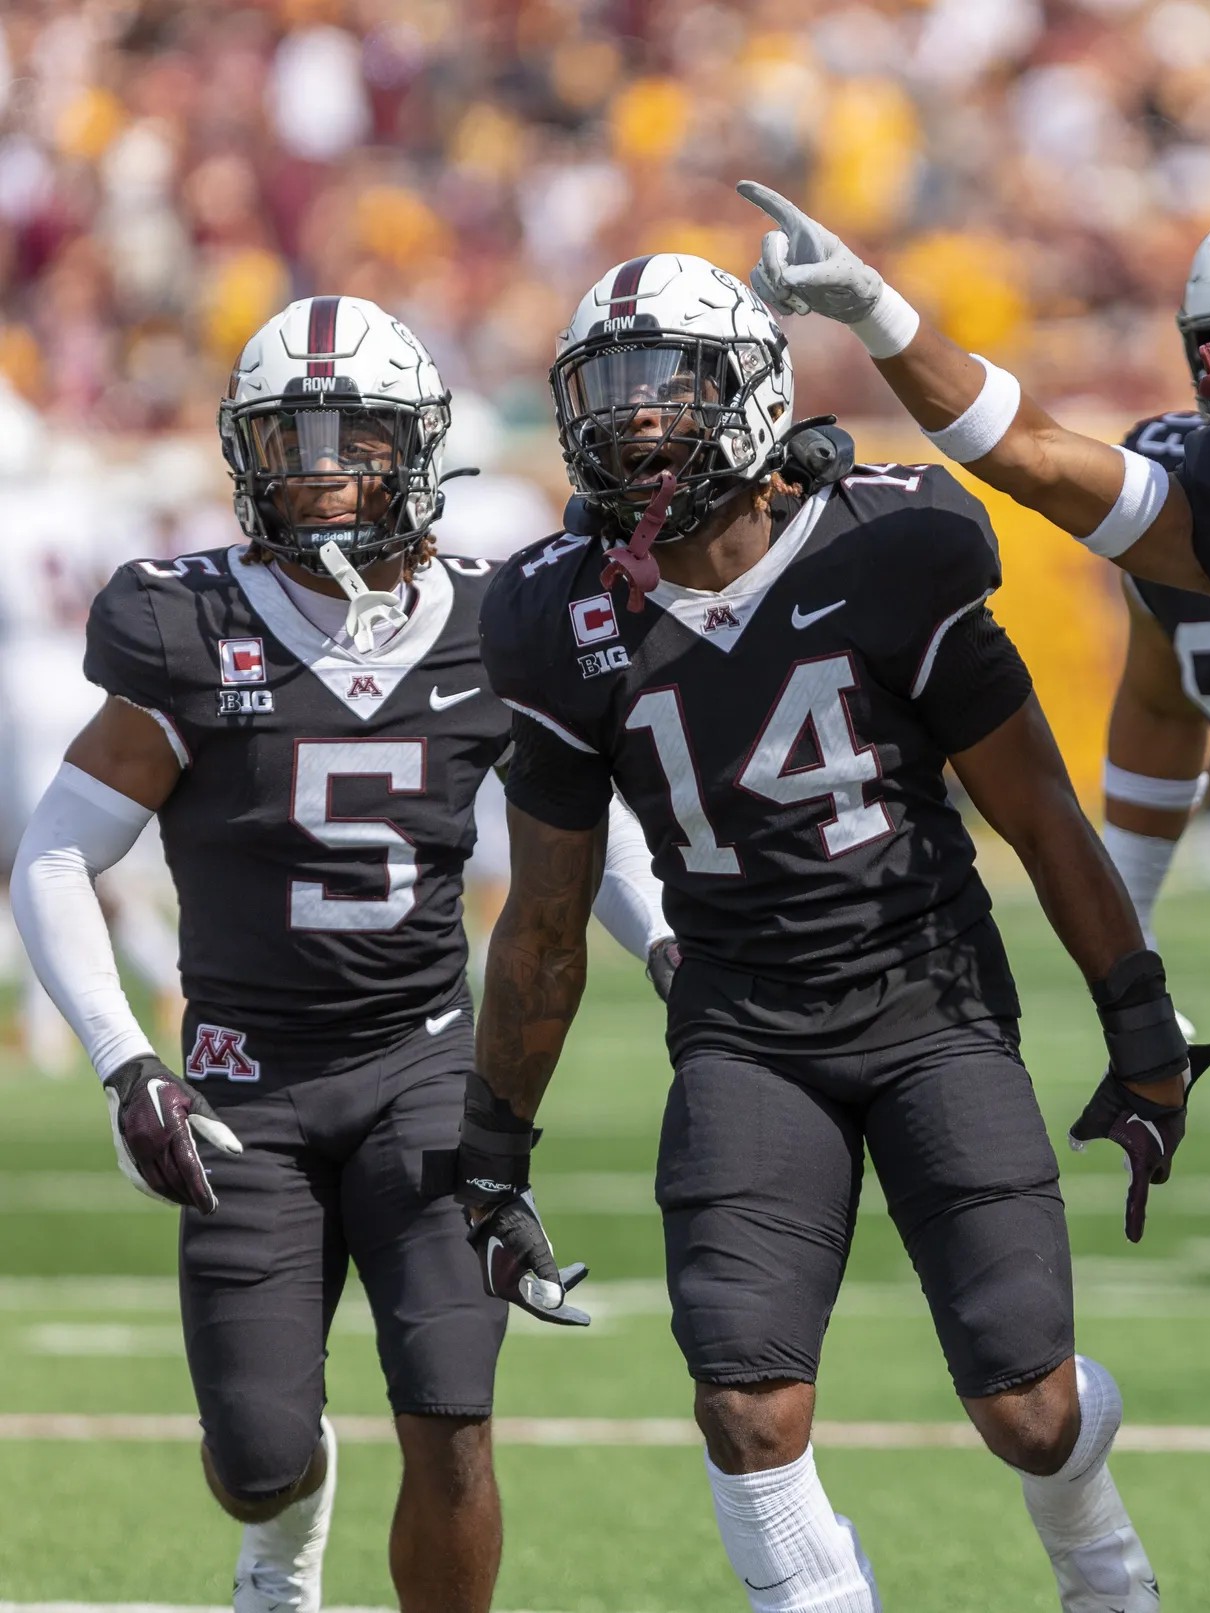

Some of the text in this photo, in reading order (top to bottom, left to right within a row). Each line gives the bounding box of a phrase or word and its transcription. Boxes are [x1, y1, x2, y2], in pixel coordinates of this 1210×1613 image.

[603, 315, 636, 333] ROW
[302, 376, 337, 392] ROW
[311, 532, 353, 543] Riddell
[571, 595, 617, 643] C
[702, 604, 741, 634] M
[220, 640, 265, 683] C
[347, 674, 383, 698] M
[624, 650, 897, 879] 14
[287, 736, 428, 934] 5
[187, 1025, 259, 1080] M
